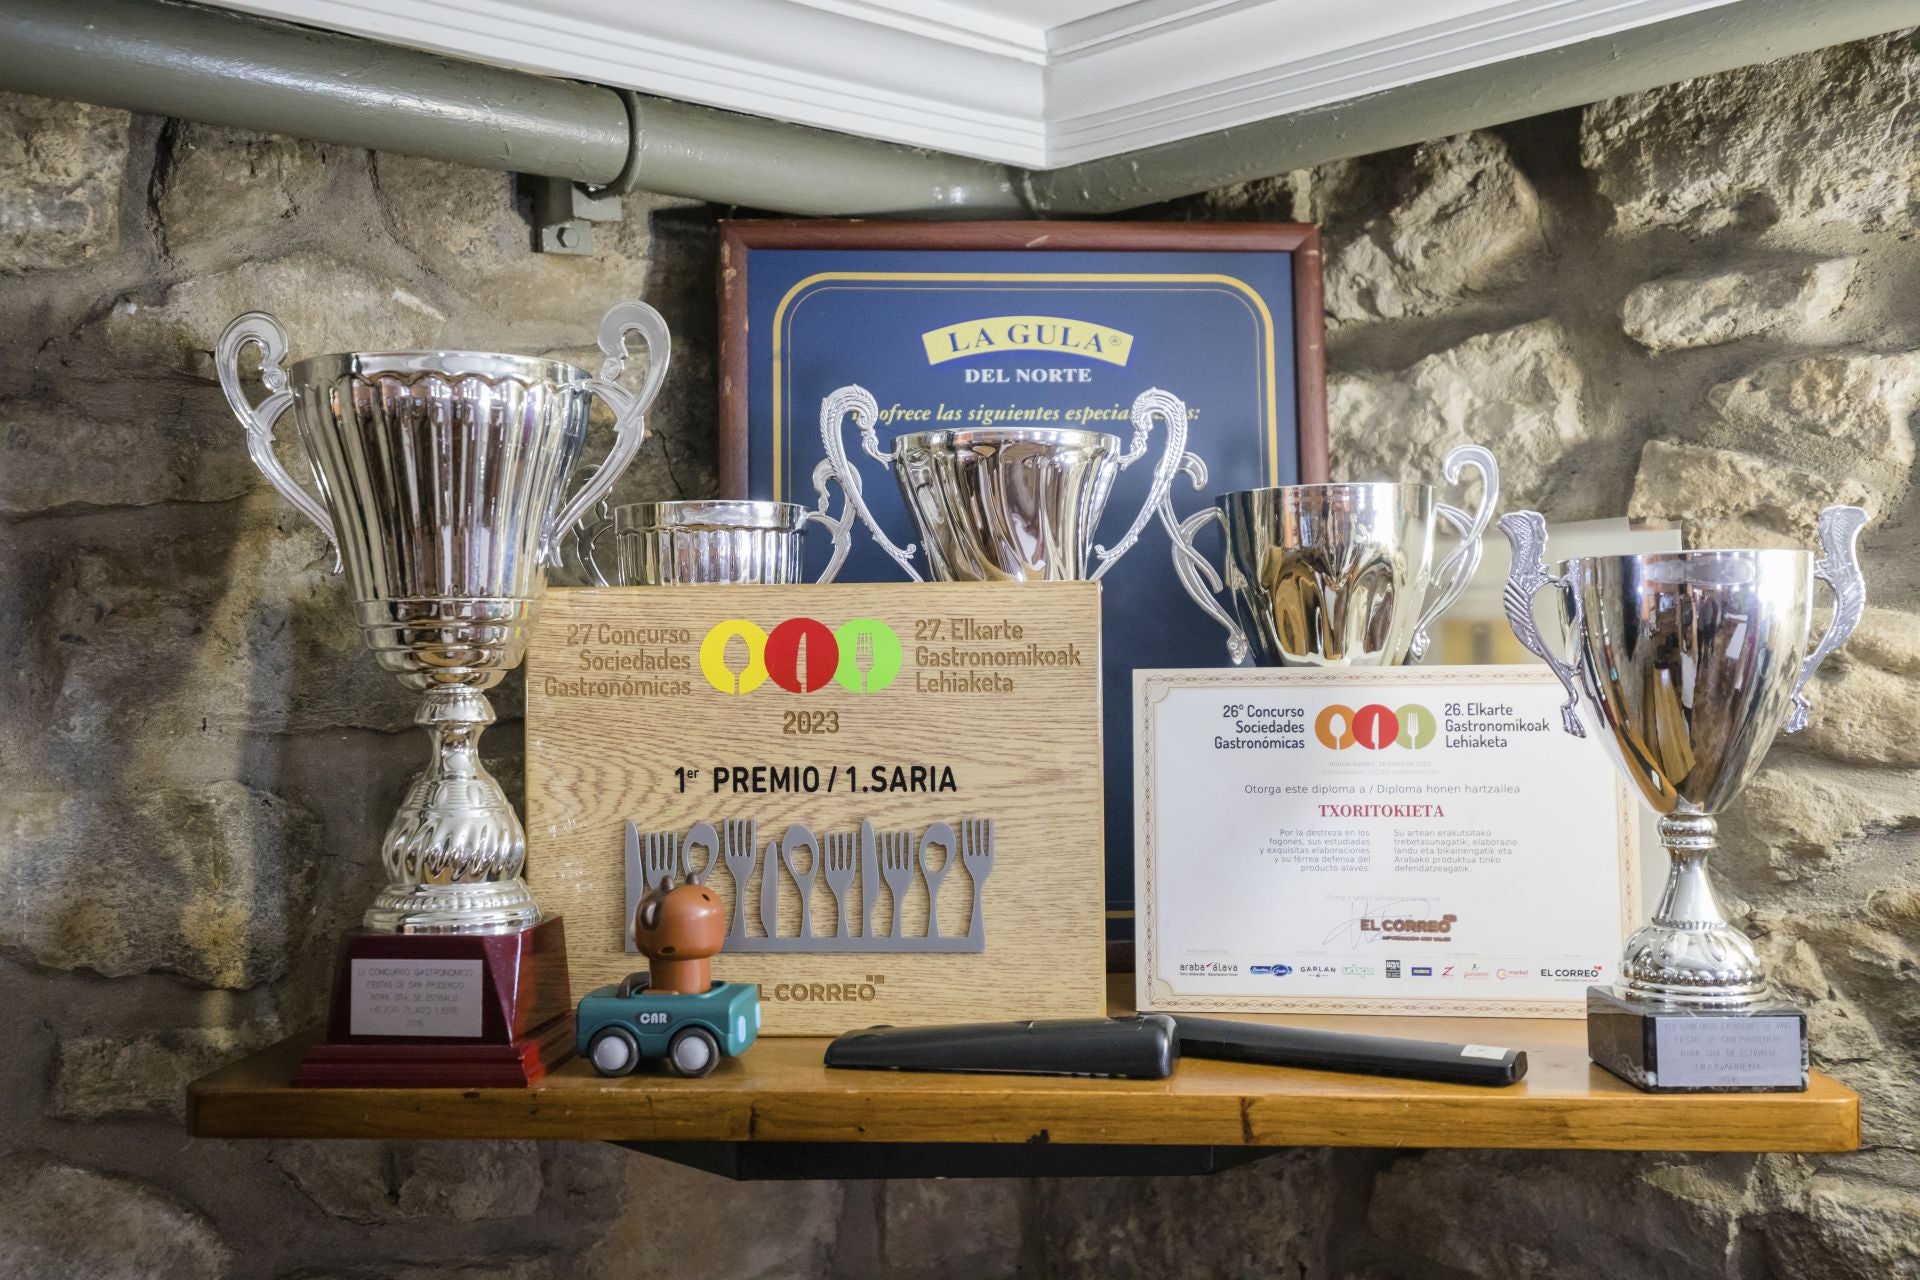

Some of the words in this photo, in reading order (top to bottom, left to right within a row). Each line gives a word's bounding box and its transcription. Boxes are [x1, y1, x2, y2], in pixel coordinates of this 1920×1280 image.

[947, 327, 995, 353] LA
[964, 367, 1010, 384] DEL
[1016, 367, 1092, 384] NORTE
[879, 403, 932, 425] ofrece
[936, 403, 962, 421] las
[967, 404, 1060, 425] siguientes
[597, 622, 691, 645] Concurso
[914, 619, 946, 641] 27.
[950, 618, 1023, 641] Elkarte
[578, 648, 691, 671] Sociedades
[915, 643, 1081, 668] Gastronomikoak
[544, 673, 691, 697] Gastronómicas
[915, 671, 1014, 694] Lehiaketa
[1247, 704, 1305, 718] Concurso
[1444, 703, 1464, 716] 26.
[1467, 702, 1514, 716] Elkarte
[782, 710, 840, 735] 2023
[1235, 720, 1305, 733] Sociedades
[1445, 717, 1551, 732] Gastronomikoak
[1214, 735, 1305, 750] Gastronómicas
[1445, 735, 1508, 748] Lehiaketa
[713, 765, 820, 794] PREMIO
[826, 765, 838, 793] /
[846, 764, 957, 793] 1.SARIA
[1244, 784, 1282, 795] Otorga
[1285, 784, 1309, 794] este
[1311, 784, 1356, 796] diploma
[1359, 786, 1366, 794] a
[1377, 784, 1423, 796] Diploma
[1426, 784, 1461, 794] honen
[1464, 784, 1520, 794] hartzailea
[1318, 804, 1445, 818] TXORITOKIETA
[1279, 828, 1293, 837] Por
[1296, 828, 1304, 837] la
[1306, 828, 1342, 837] destreza
[1358, 828, 1371, 837] los
[1393, 828, 1405, 837] Su
[1407, 829, 1435, 837] artean
[1437, 828, 1492, 837] erakutsitako
[1269, 837, 1305, 847] fogones,
[1324, 837, 1371, 846] estudiadas
[1267, 846, 1309, 856] exquisitas
[1311, 846, 1371, 855] elaboraciones
[1394, 847, 1417, 855] landu
[1437, 847, 1495, 857] bikainengatik
[1321, 855, 1356, 863] defensa
[1358, 855, 1371, 863] del
[1394, 856, 1430, 864] Arabako
[1432, 856, 1477, 865] produktua
[1479, 856, 1502, 864] tinko
[1300, 864, 1338, 873] producto
[1360, 918, 1381, 931] EL
[1382, 918, 1452, 933] CORREO
[1179, 962, 1205, 971] araba
[1213, 962, 1238, 971] álava
[1540, 969, 1554, 977] EL
[1554, 969, 1599, 978] CORREO
[774, 983, 876, 1002] CORREO
[639, 1012, 668, 1025] CAR
